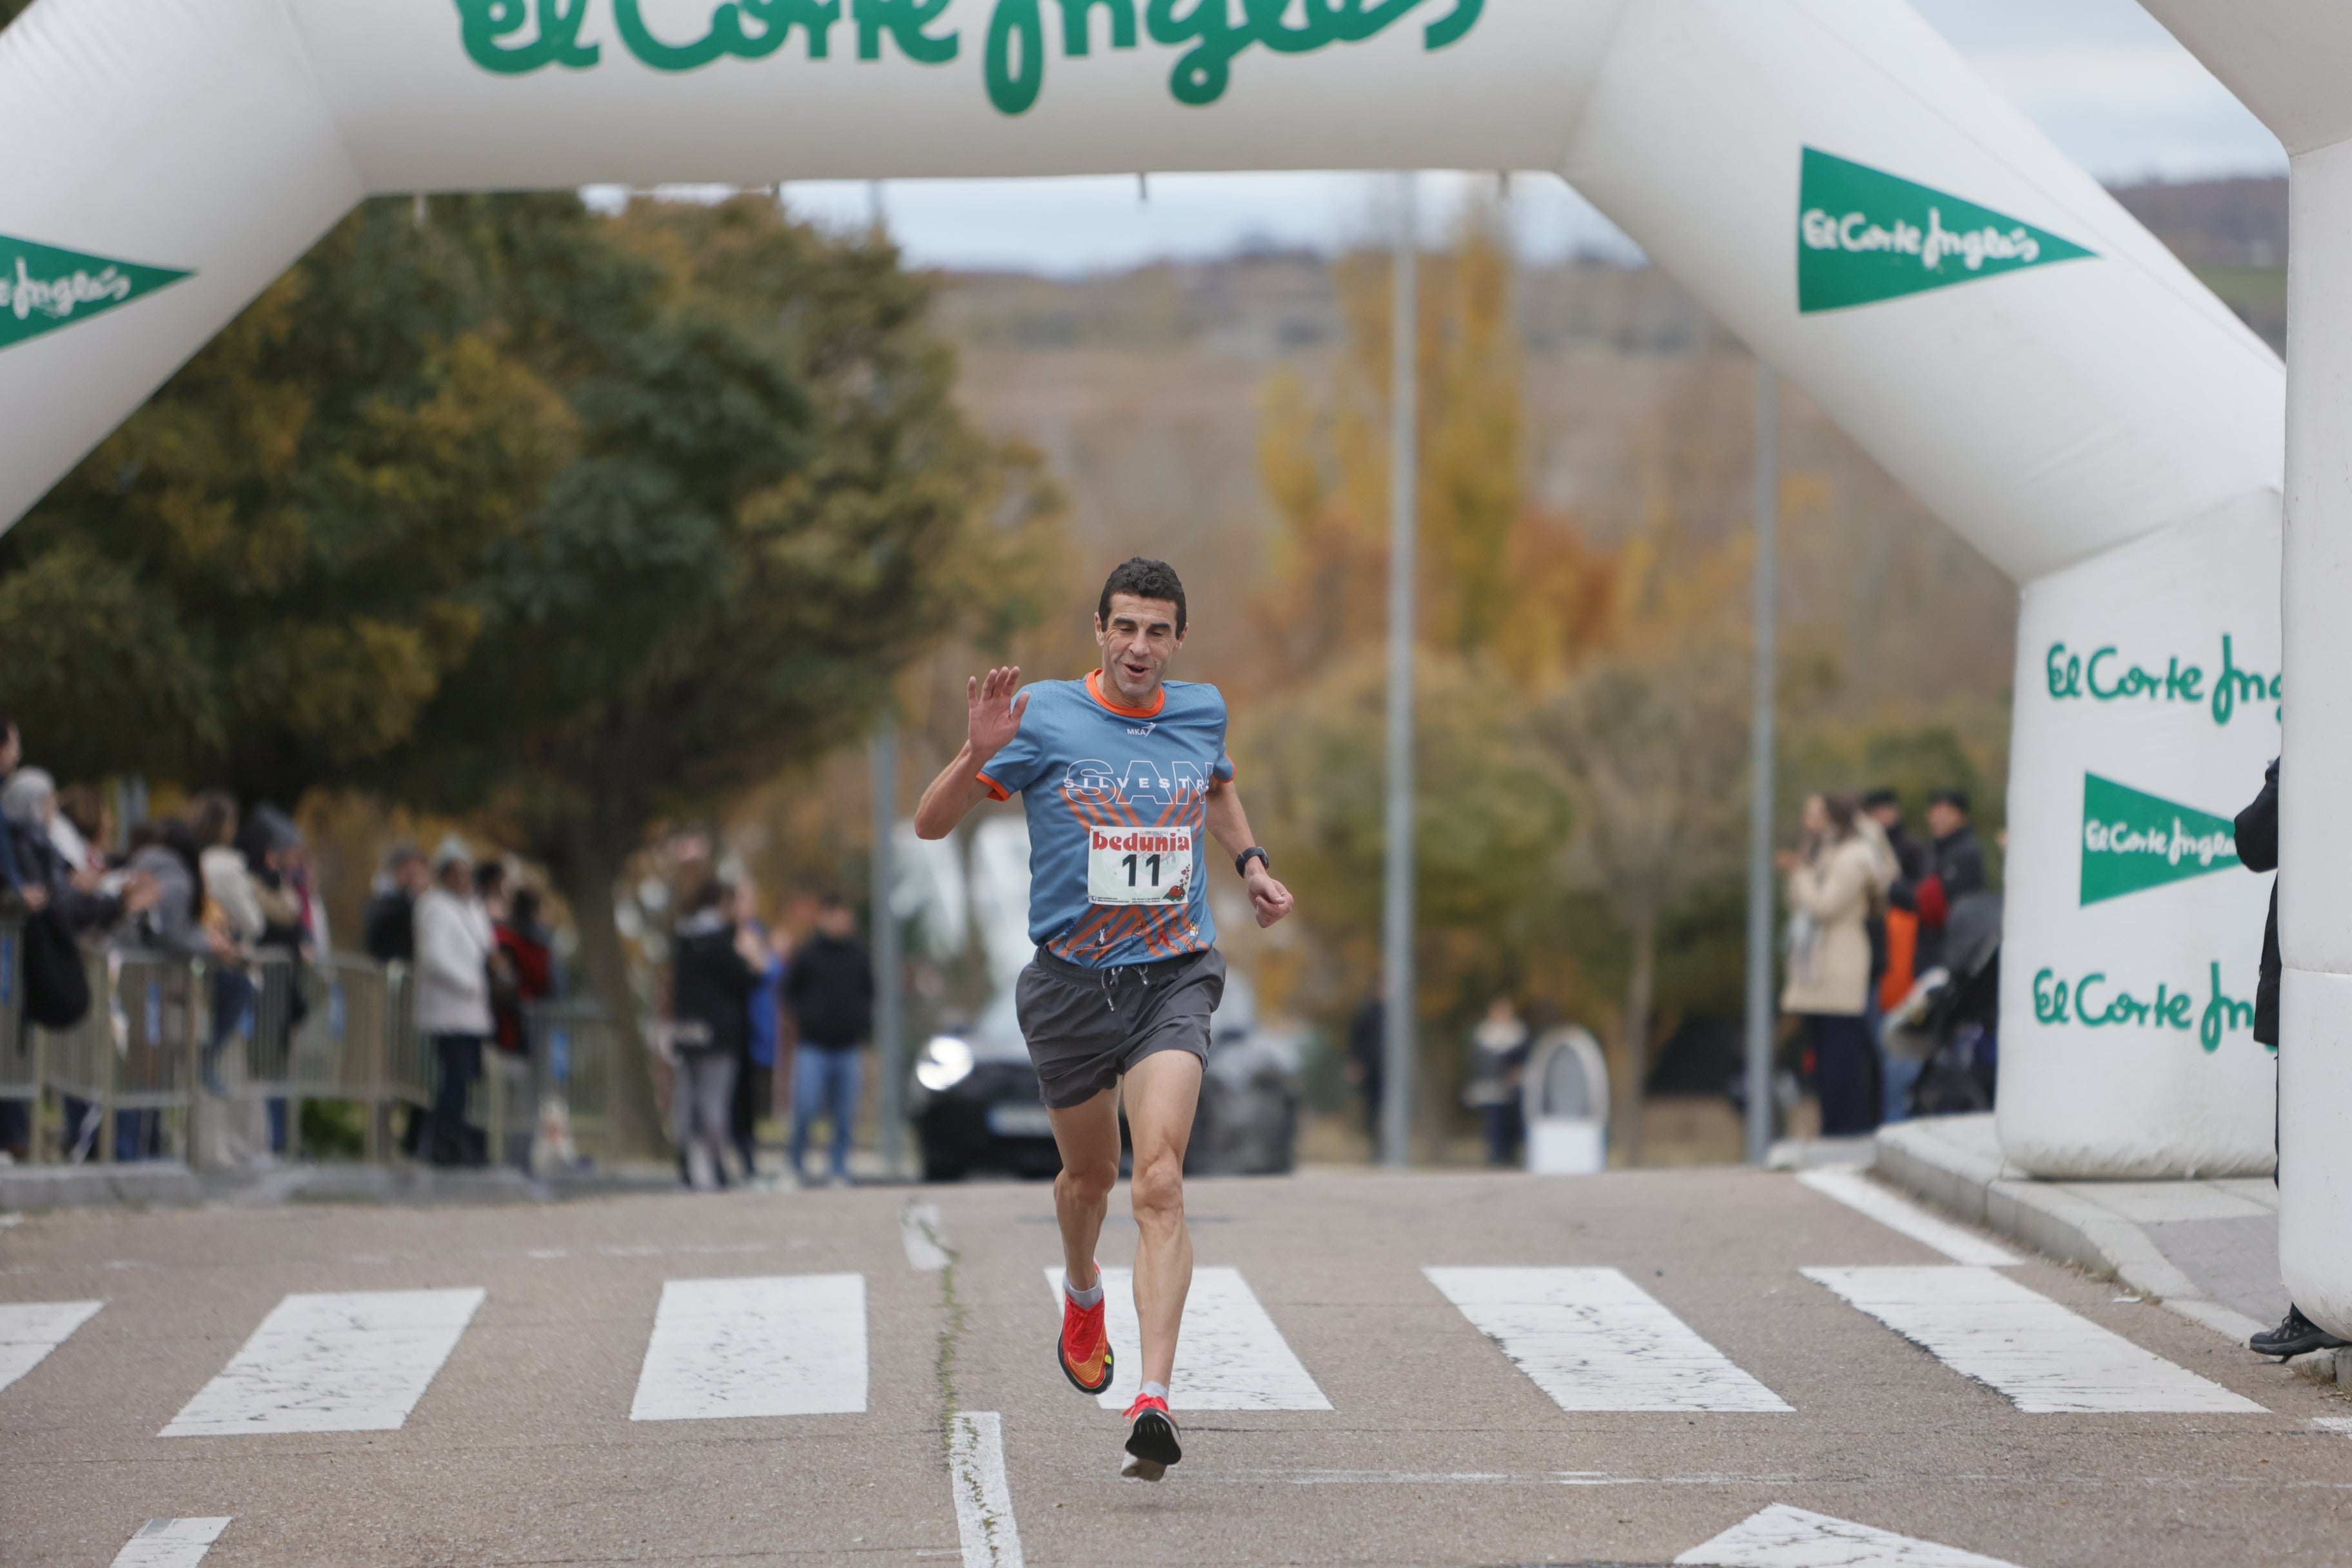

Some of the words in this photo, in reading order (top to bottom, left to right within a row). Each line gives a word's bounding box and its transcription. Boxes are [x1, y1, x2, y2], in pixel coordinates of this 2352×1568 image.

[1803, 209, 1838, 250] El
[1839, 212, 1921, 255] Corte
[2047, 642, 2082, 699] El
[2088, 646, 2204, 701] Corte
[1126, 728, 1146, 736] MKA
[1066, 759, 1213, 805] SAN
[1092, 831, 1190, 852] bedunia
[2085, 819, 2109, 851] El
[2110, 821, 2167, 855] Corte
[1122, 854, 1161, 887] 11
[2034, 967, 2070, 1024] El
[2075, 973, 2191, 1029] Corte
